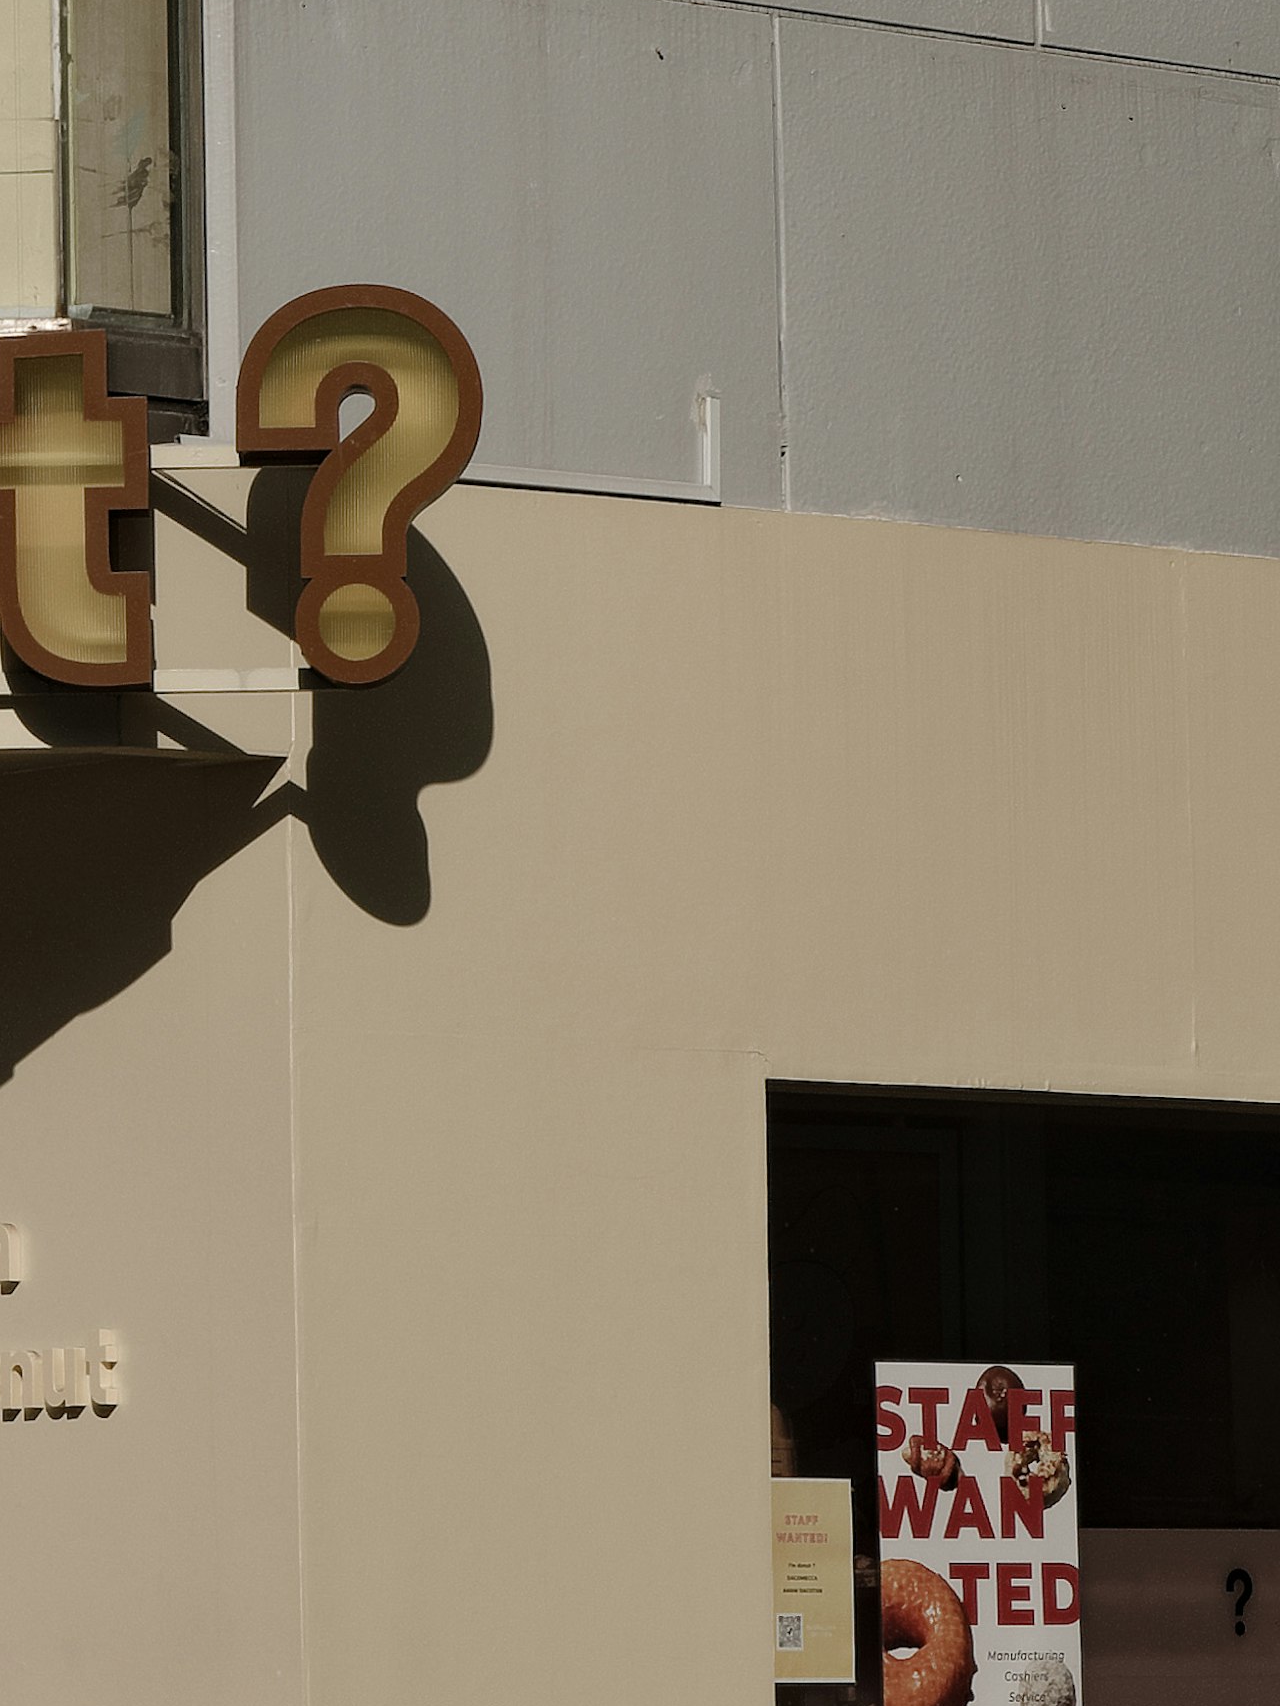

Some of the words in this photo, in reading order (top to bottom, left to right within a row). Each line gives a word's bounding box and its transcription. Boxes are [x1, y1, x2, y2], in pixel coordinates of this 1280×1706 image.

[237, 284, 482, 686] ?
[878, 1475, 1045, 1539] WAN
[949, 1562, 1080, 1626] TED
[1226, 1568, 1253, 1636] ?
[987, 1648, 1065, 1663] Manufacturing
[1004, 1670, 1049, 1682] Cashiers
[1009, 1691, 1046, 1703] Service
